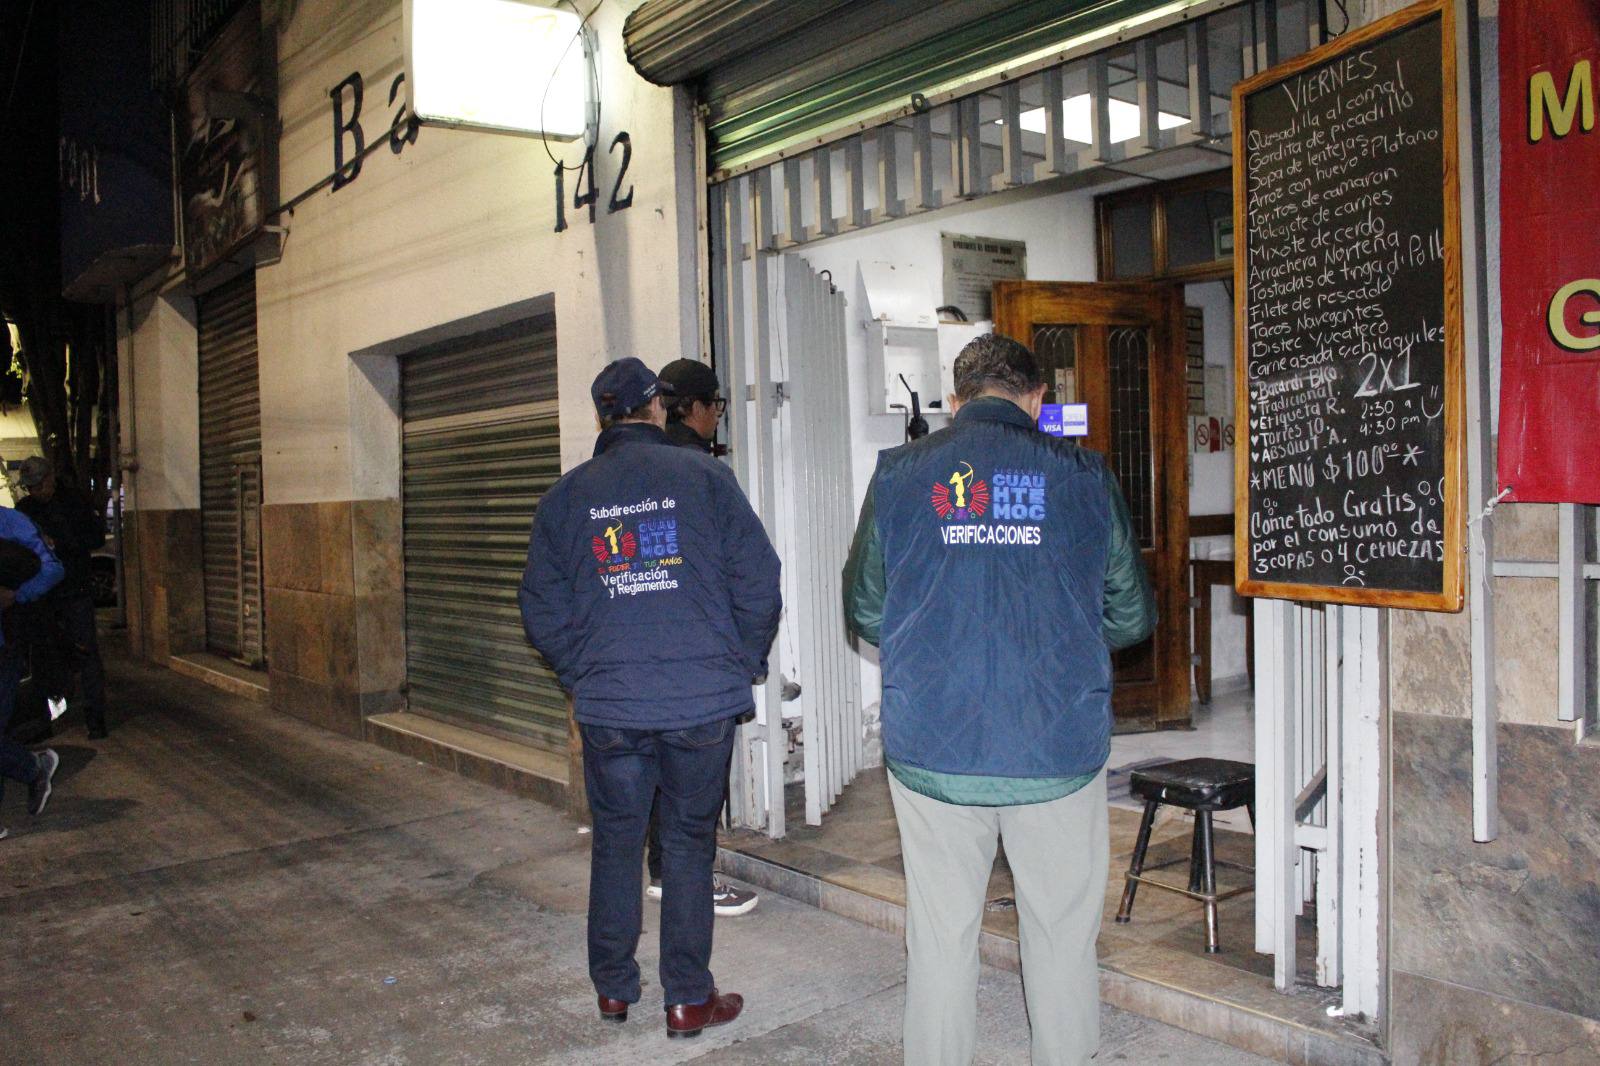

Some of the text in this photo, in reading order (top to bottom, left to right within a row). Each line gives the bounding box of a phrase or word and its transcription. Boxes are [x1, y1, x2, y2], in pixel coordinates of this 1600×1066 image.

[1282, 51, 1377, 112] VIERNES
[1326, 95, 1341, 120] al
[1346, 60, 1405, 110] comal
[1248, 91, 1414, 170] Gordita de picadillo
[1249, 134, 1369, 192] Sopa de lentejas
[554, 131, 634, 232] 142
[1249, 188, 1284, 211] Arroz
[1288, 178, 1312, 195] con
[1316, 157, 1358, 181] huevo
[1249, 168, 1398, 227] Toritos de camaron
[1312, 206, 1330, 226] de
[1335, 190, 1393, 216] carnes
[1250, 209, 1385, 266] Mixote de cerdo
[1249, 231, 1399, 284] Arrachera Norteña
[1249, 275, 1392, 322] Filete de pescado
[1250, 276, 1314, 303] Tostadas
[1317, 266, 1336, 286] de
[1340, 260, 1382, 285] tinga
[1250, 304, 1384, 339] Tacos Navegantes
[1252, 319, 1389, 358] Bistec Yucateco
[1249, 357, 1287, 380] Carne
[1289, 343, 1334, 368] asada
[1260, 402, 1321, 431] Etiqueta
[1360, 415, 1421, 436] 4:30 pm
[1361, 400, 1395, 419] 2:30
[1043, 424, 1062, 433] VISA
[1259, 424, 1302, 447] Torres
[992, 473, 1046, 488] CUAU
[1262, 456, 1315, 490] MENÚ
[589, 497, 676, 520] Subdirección de
[993, 486, 1045, 504] HTE
[993, 503, 1045, 520] MOC
[1251, 486, 1416, 539] Come todo Gratis
[940, 525, 1041, 545] VERIFICACIONES
[1253, 507, 1440, 561] por el consumo de
[1338, 541, 1348, 562] 4
[600, 566, 669, 587] Verificación
[608, 579, 679, 599] y Reglamentos
